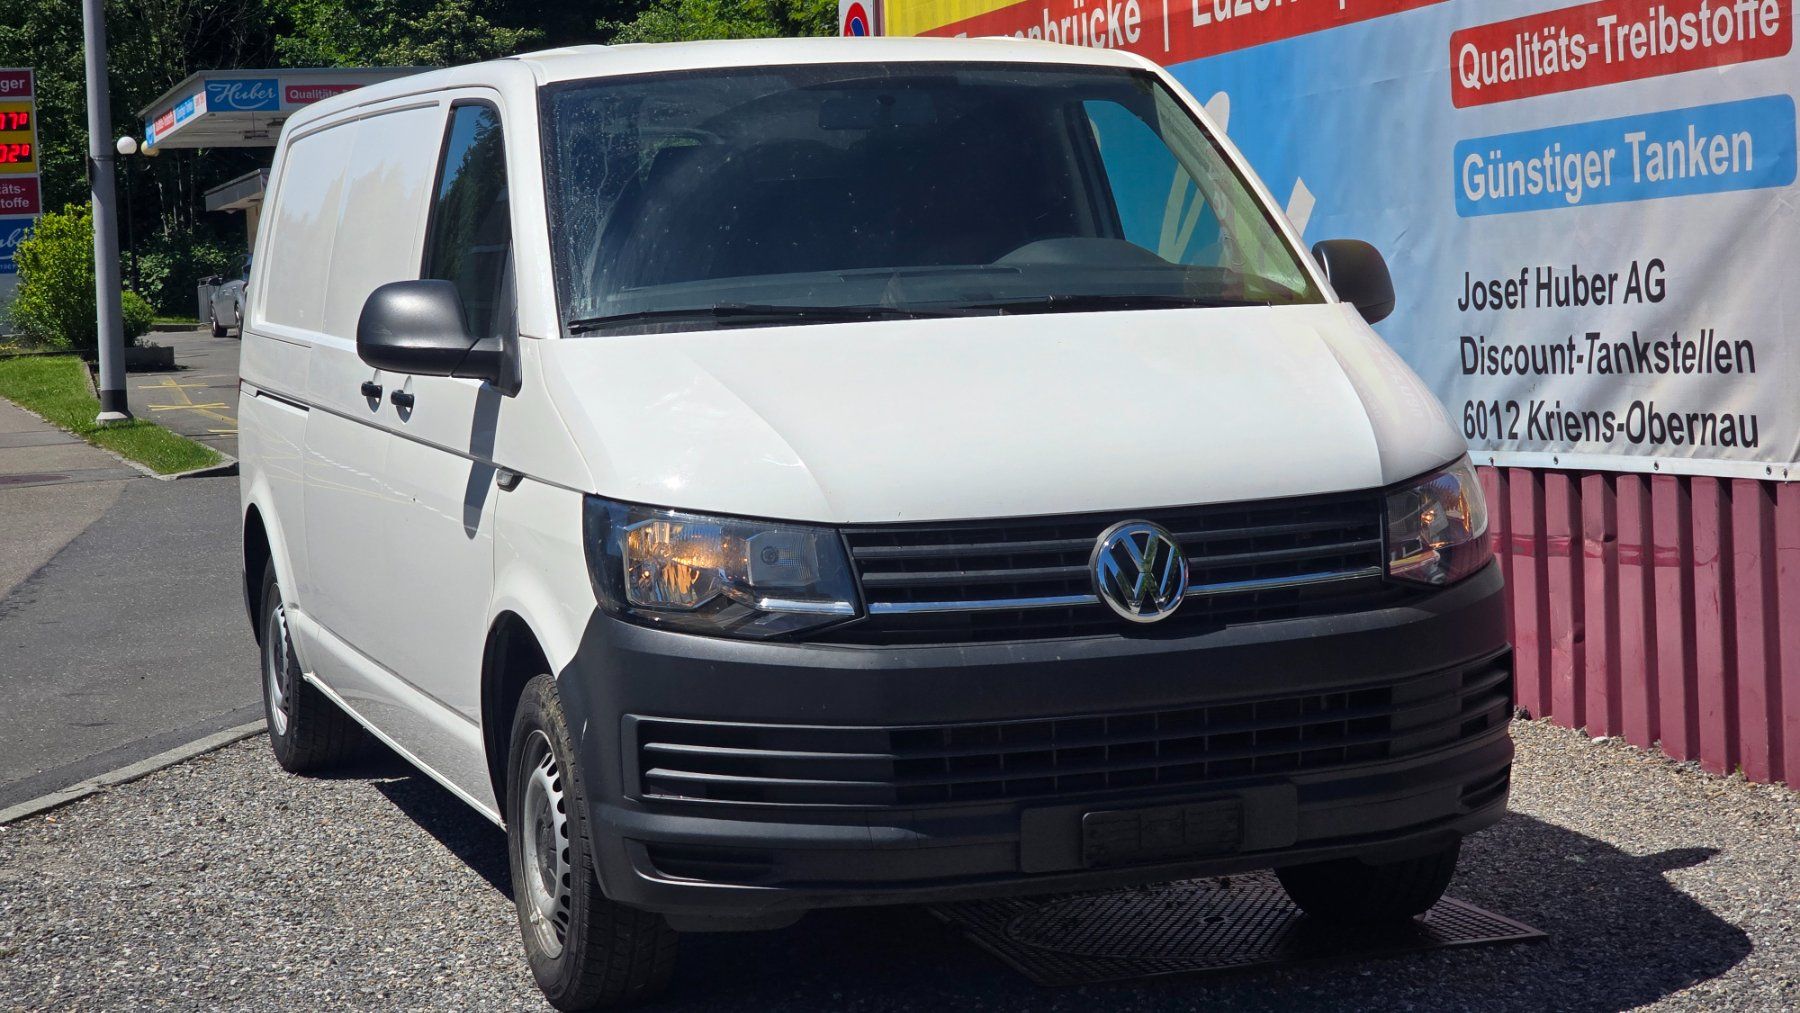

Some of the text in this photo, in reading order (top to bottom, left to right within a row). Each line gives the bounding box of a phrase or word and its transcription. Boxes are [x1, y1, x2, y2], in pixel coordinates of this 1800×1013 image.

[1458, 0, 1780, 90] Qualitäts-Treibstoffe
[207, 82, 277, 110] Huber
[1462, 125, 1753, 204] Günstiger Tanken
[1457, 258, 1667, 312] Josef Huber AG
[1459, 328, 1757, 376] Discount-Tankstellen
[1463, 400, 1760, 449] 6012 Kriens-Obernau
